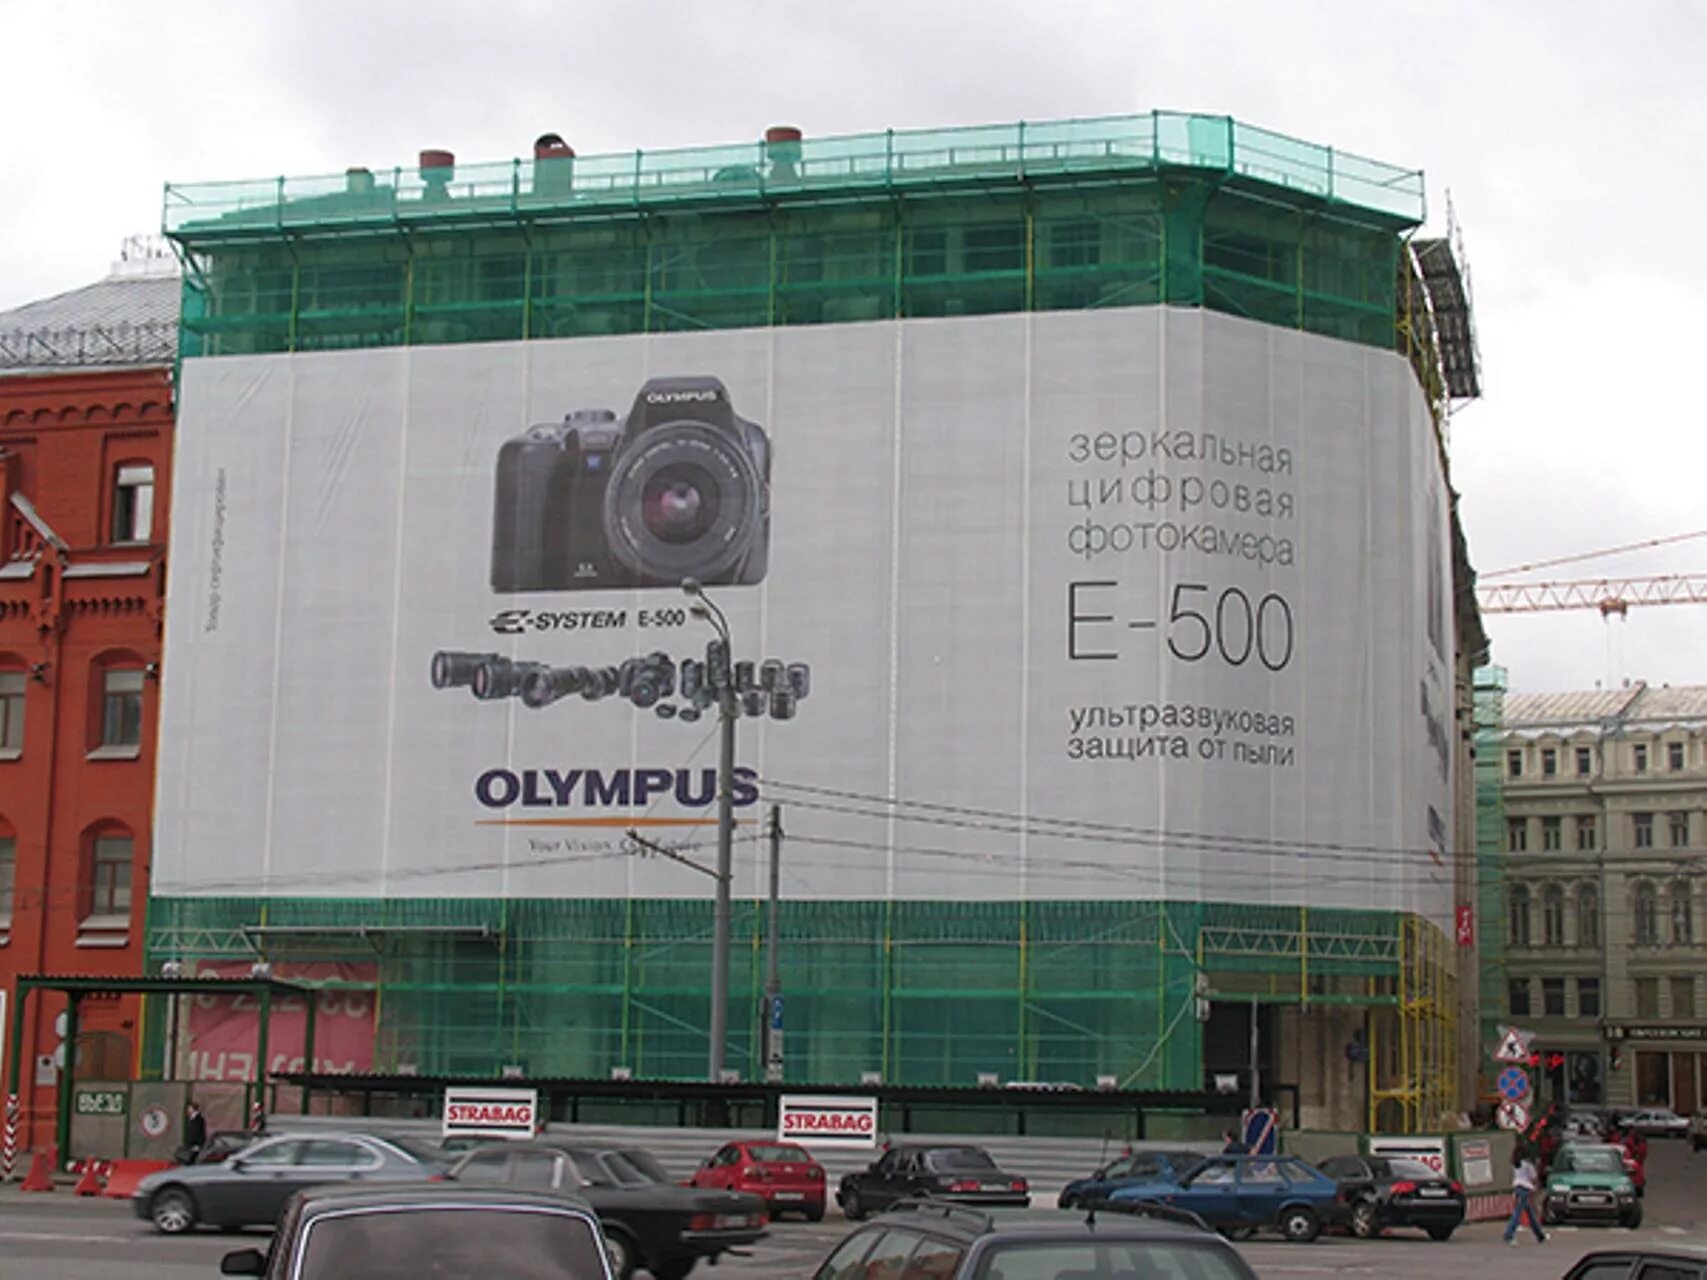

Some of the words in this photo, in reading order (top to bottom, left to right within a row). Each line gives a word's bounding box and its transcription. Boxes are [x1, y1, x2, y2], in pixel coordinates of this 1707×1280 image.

[647, 391, 717, 404] OLYMPUS
[1068, 430, 1293, 475] зеркальная
[1068, 469, 1294, 518] цифровая
[1067, 519, 1294, 567] фотокамера
[637, 609, 686, 628] E-500
[1067, 580, 1293, 672] E-500
[1069, 704, 1295, 737] ультразвуковая
[1067, 736, 1188, 762] защита
[1198, 739, 1226, 760] от
[1233, 744, 1295, 767] пыли
[475, 767, 760, 808] OLYMPUS
[448, 1103, 532, 1124] STRABAG
[784, 1112, 874, 1132] STRABAG
